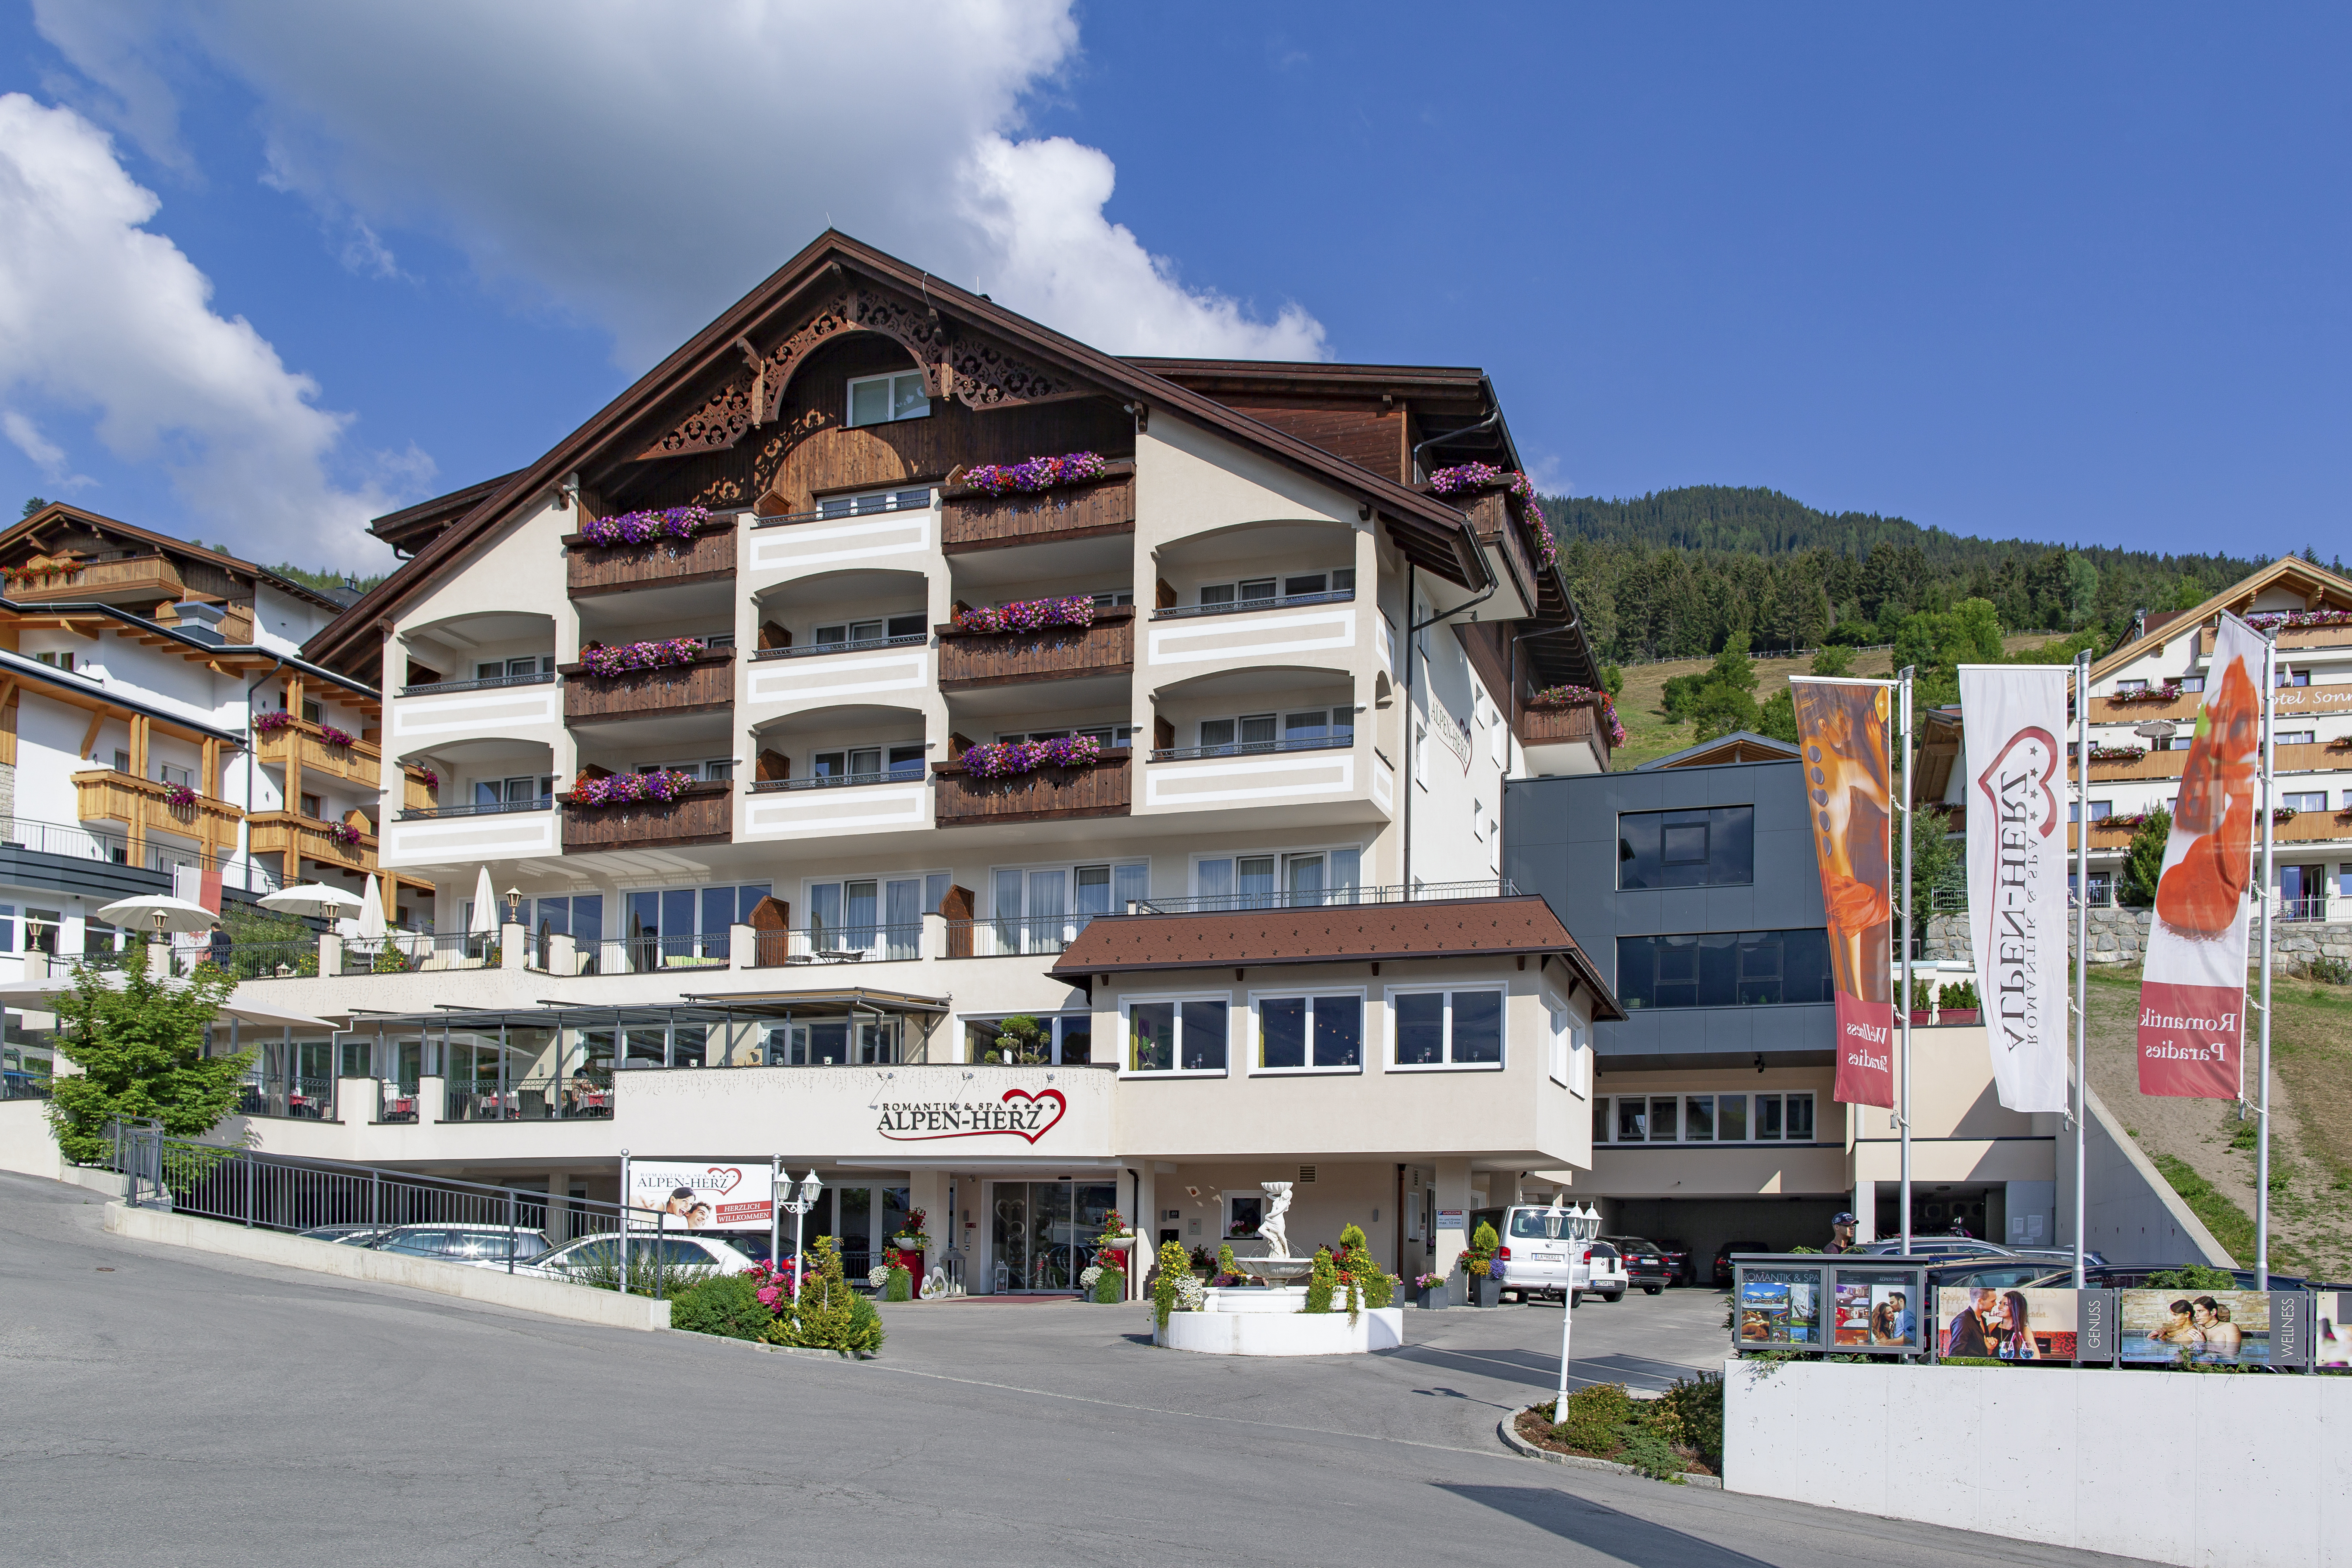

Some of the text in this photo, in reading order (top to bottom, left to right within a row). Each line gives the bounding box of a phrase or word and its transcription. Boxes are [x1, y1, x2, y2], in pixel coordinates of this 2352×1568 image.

[1431, 700, 1467, 764] ALPEN-HERZ
[882, 1102, 1003, 1111] ROMANTIK & SPA
[877, 1110, 1041, 1130] ALPEN-HERZ
[637, 1177, 728, 1188] ALPEN-HERZ
[724, 1203, 761, 1212] HERZLICH
[718, 1212, 770, 1222] WILLKOMMEN
[1743, 1273, 1820, 1282] ROMANTIK & SPA
[2088, 1300, 2101, 1348] GENUSS
[2281, 1298, 2294, 1357] WELLNESS
